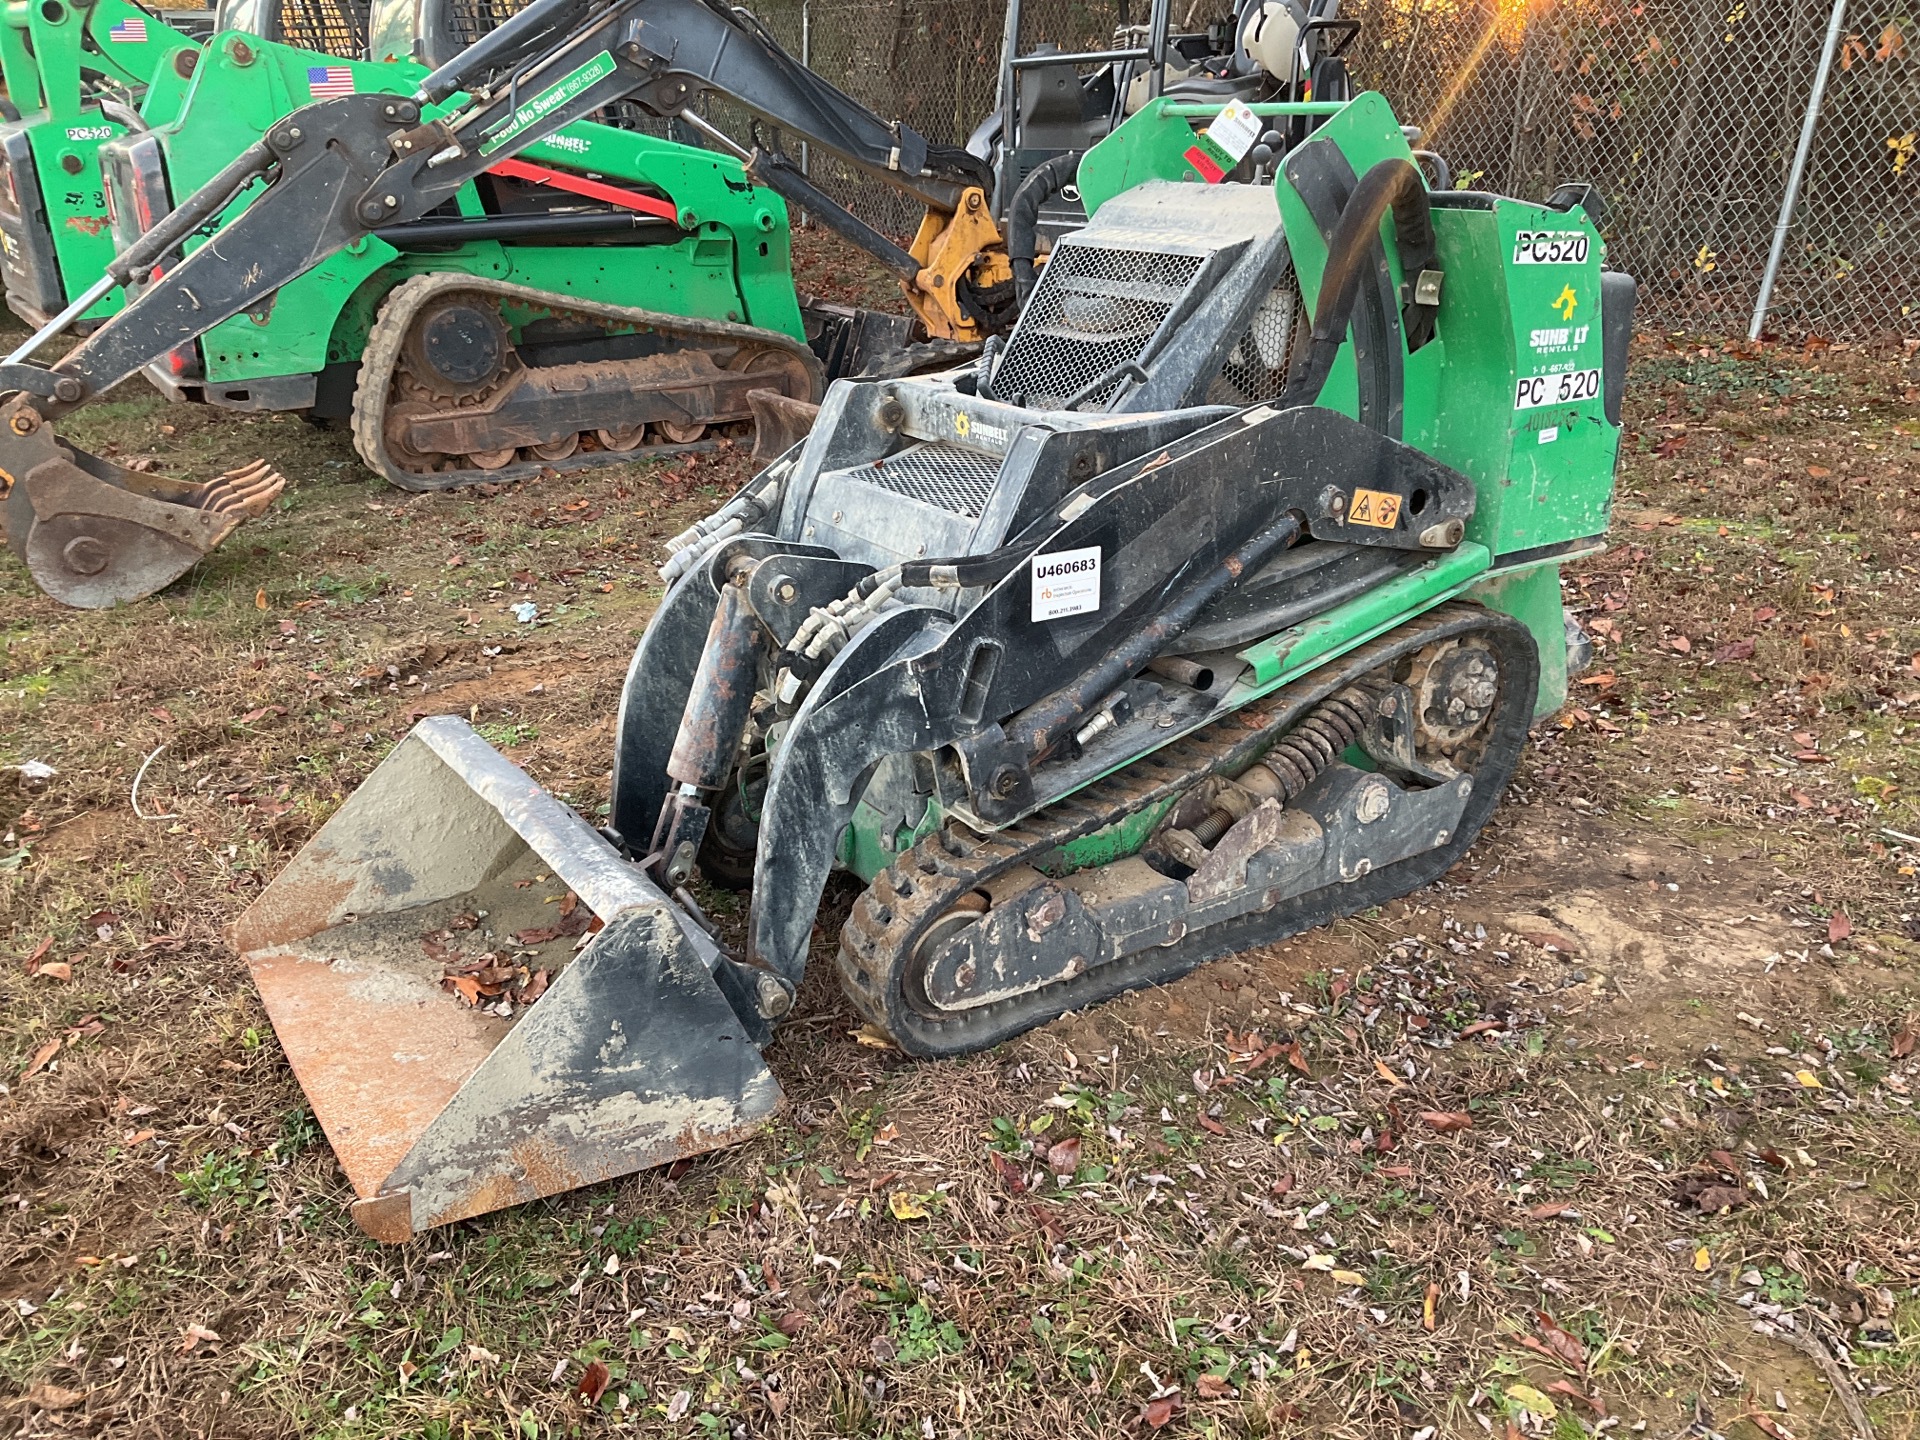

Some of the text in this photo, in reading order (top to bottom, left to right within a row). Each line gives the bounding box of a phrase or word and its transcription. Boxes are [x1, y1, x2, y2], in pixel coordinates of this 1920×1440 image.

[516, 109, 535, 125] No
[566, 64, 604, 93] (667-9328)
[67, 127, 112, 139] PC520
[1223, 153, 1232, 163] TO
[1515, 233, 1588, 262] PC520
[1536, 344, 1579, 354] RENTALS
[1516, 370, 1599, 408] PC 520
[970, 421, 1008, 442] SUNBELT
[976, 433, 1003, 446] RENTALS
[1037, 558, 1096, 579] U460683
[1041, 588, 1052, 600] rb
